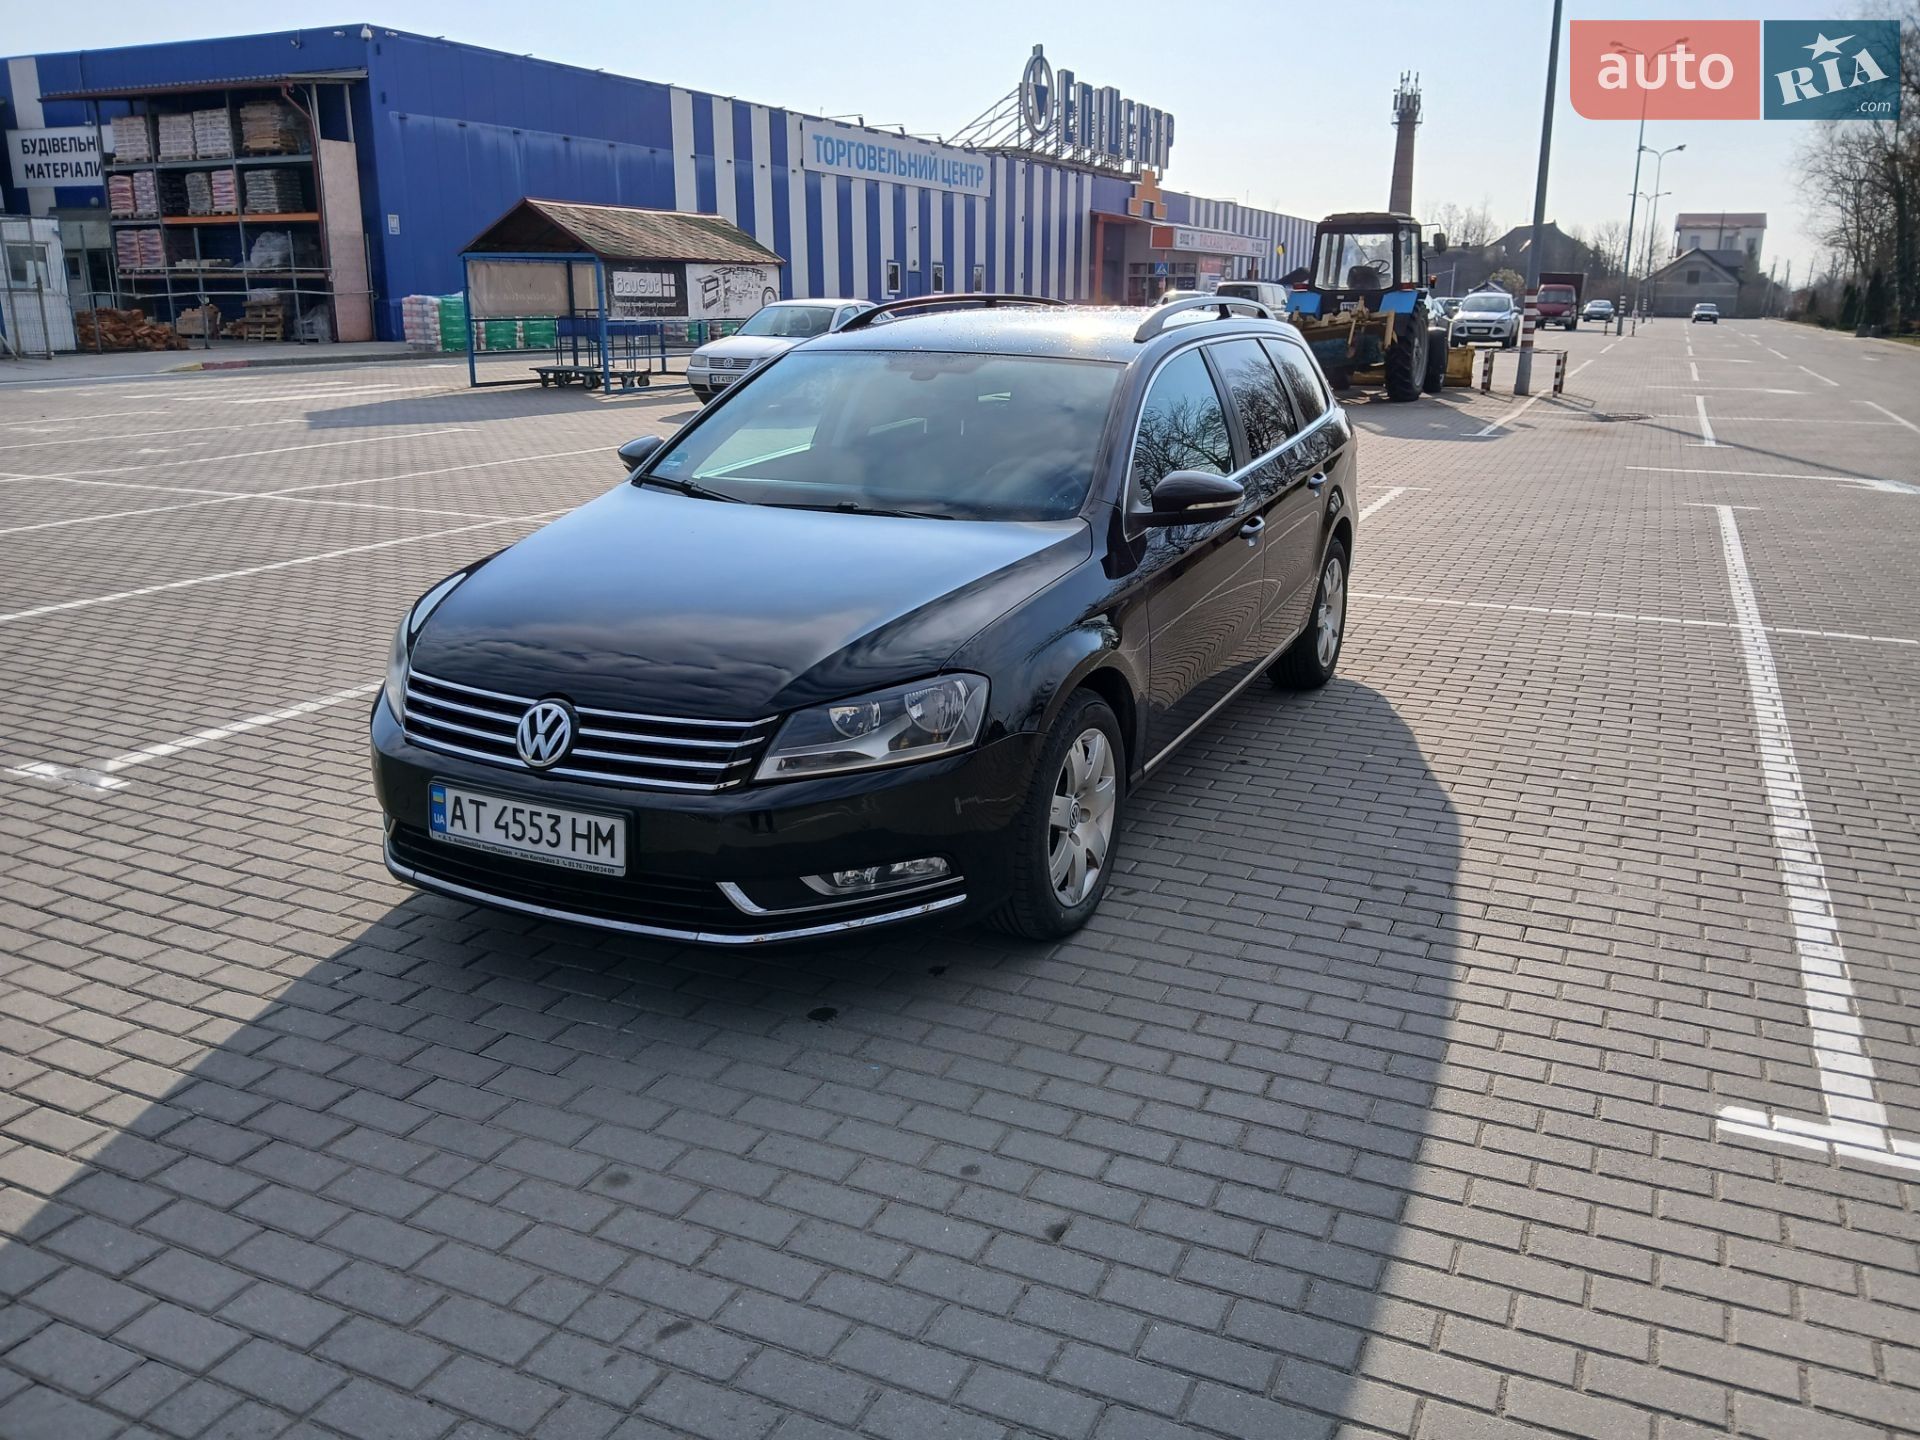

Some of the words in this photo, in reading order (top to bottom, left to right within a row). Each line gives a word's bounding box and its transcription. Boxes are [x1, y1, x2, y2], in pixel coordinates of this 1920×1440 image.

[24, 161, 102, 179] МАТЕРІАЛИ
[812, 134, 938, 182] ТОРГОВЕЛЬНИЙ
[941, 158, 985, 189] ЦЕНТР
[434, 813, 445, 825] UA
[450, 796, 487, 834] AT
[494, 806, 561, 848] 4553
[571, 817, 616, 859] HM
